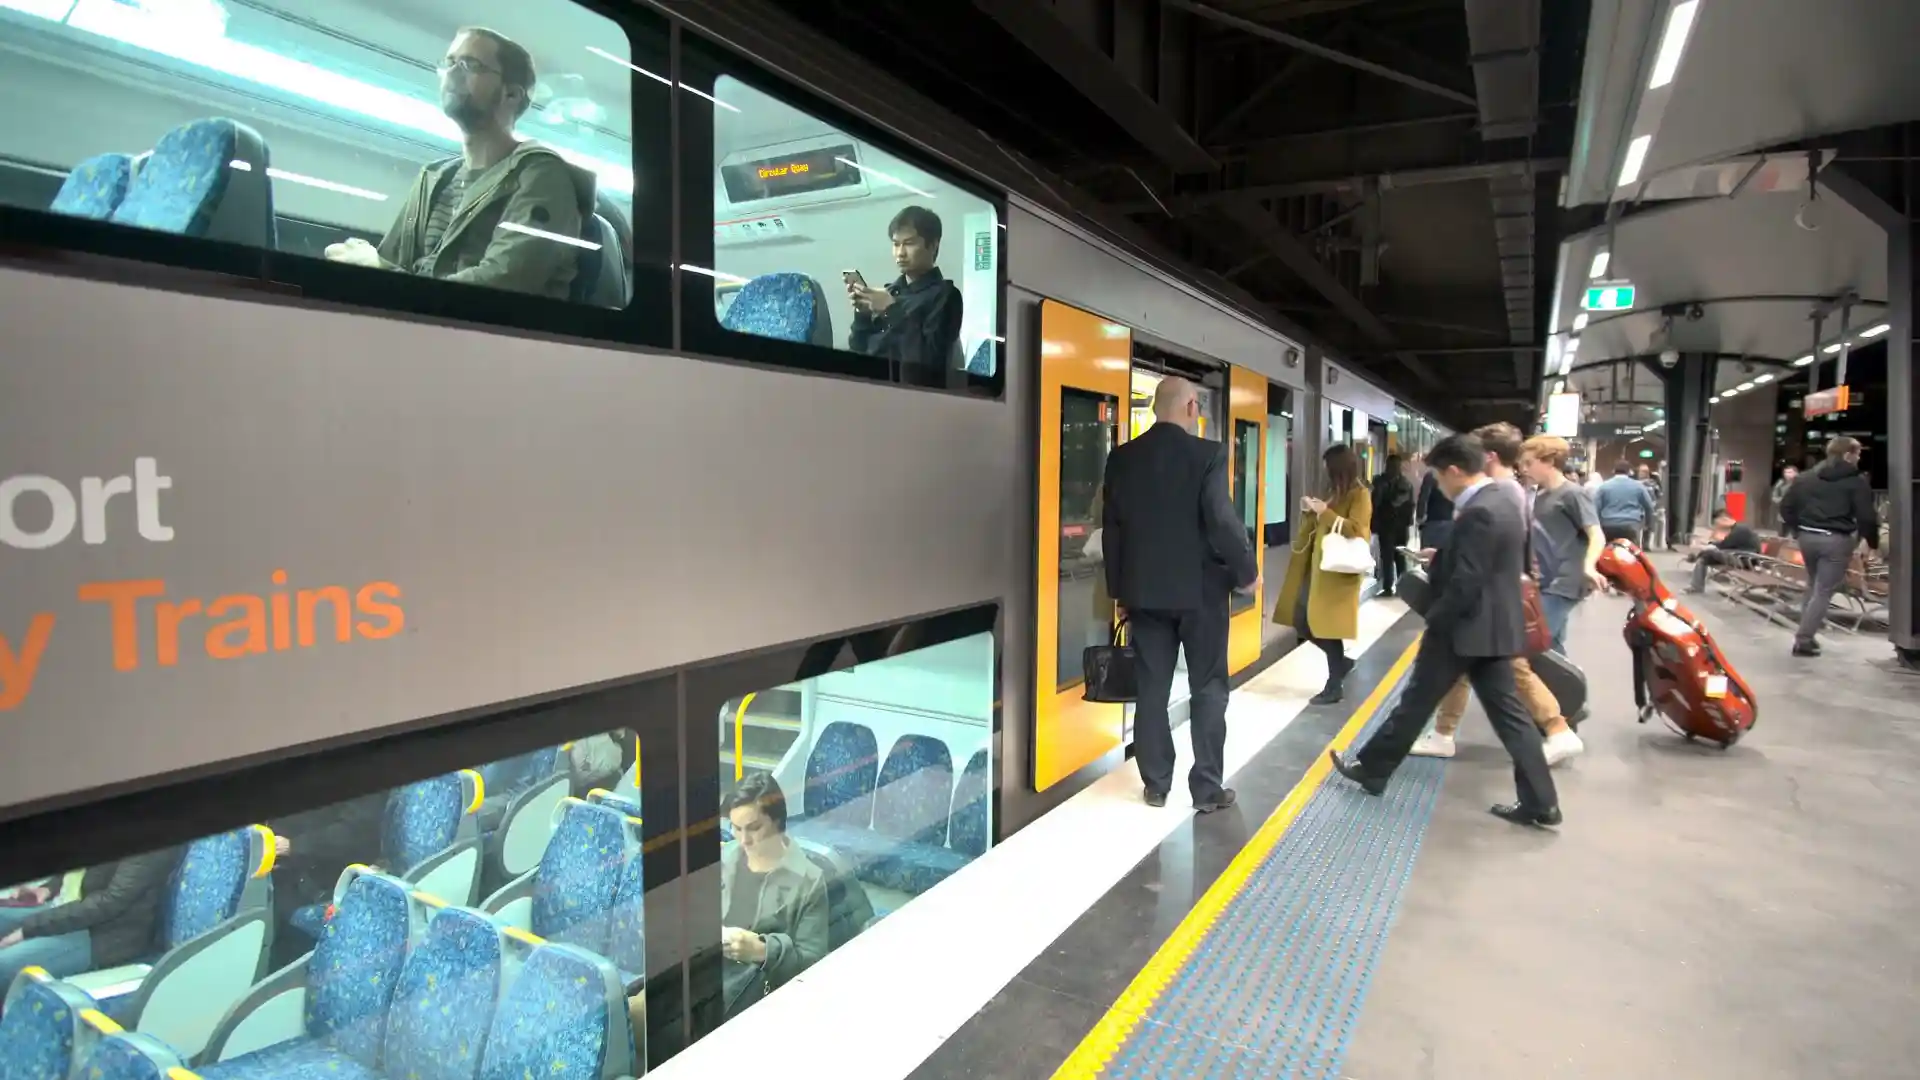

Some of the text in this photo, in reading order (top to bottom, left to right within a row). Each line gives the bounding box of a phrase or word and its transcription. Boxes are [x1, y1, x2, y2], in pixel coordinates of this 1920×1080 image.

[759, 163, 809, 179] Circular Quay
[78, 569, 405, 672] Trains
